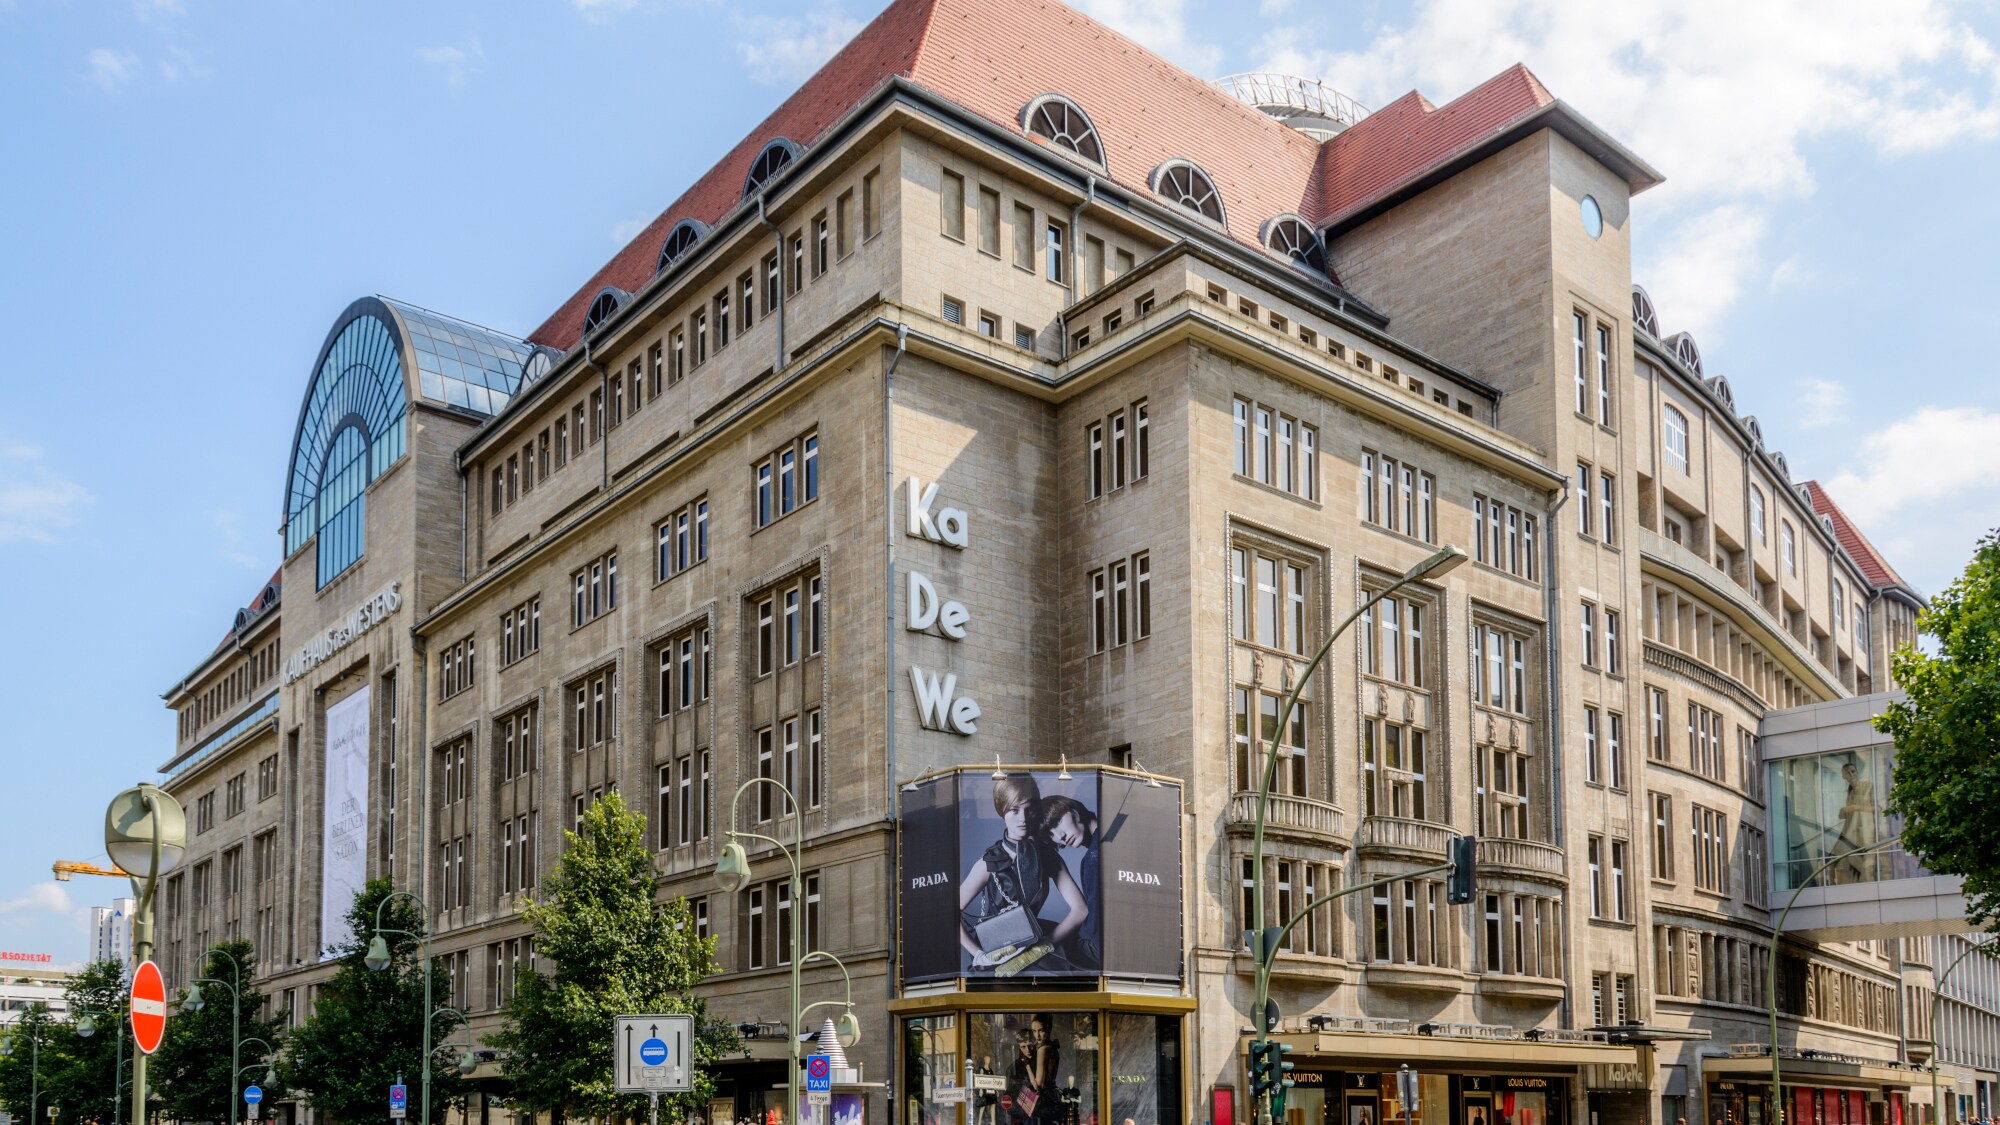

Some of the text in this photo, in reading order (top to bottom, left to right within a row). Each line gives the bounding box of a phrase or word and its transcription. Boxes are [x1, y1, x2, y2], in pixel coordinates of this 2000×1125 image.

[906, 475, 969, 550] Ka
[906, 569, 971, 642] De
[283, 626, 337, 687] KAUFHAUS
[346, 580, 402, 642] WESTENS
[908, 664, 983, 737] We
[341, 797, 355, 816] DER
[331, 812, 364, 838] BERLINER
[912, 872, 948, 889] PRADA
[1118, 870, 1161, 886] PRADA
[1293, 1073, 1323, 1083] VUITTON
[1608, 1063, 1643, 1082] KaDeWe
[809, 1080, 829, 1089] TAXI
[1508, 1078, 1547, 1087] LOUIS VUITTON
